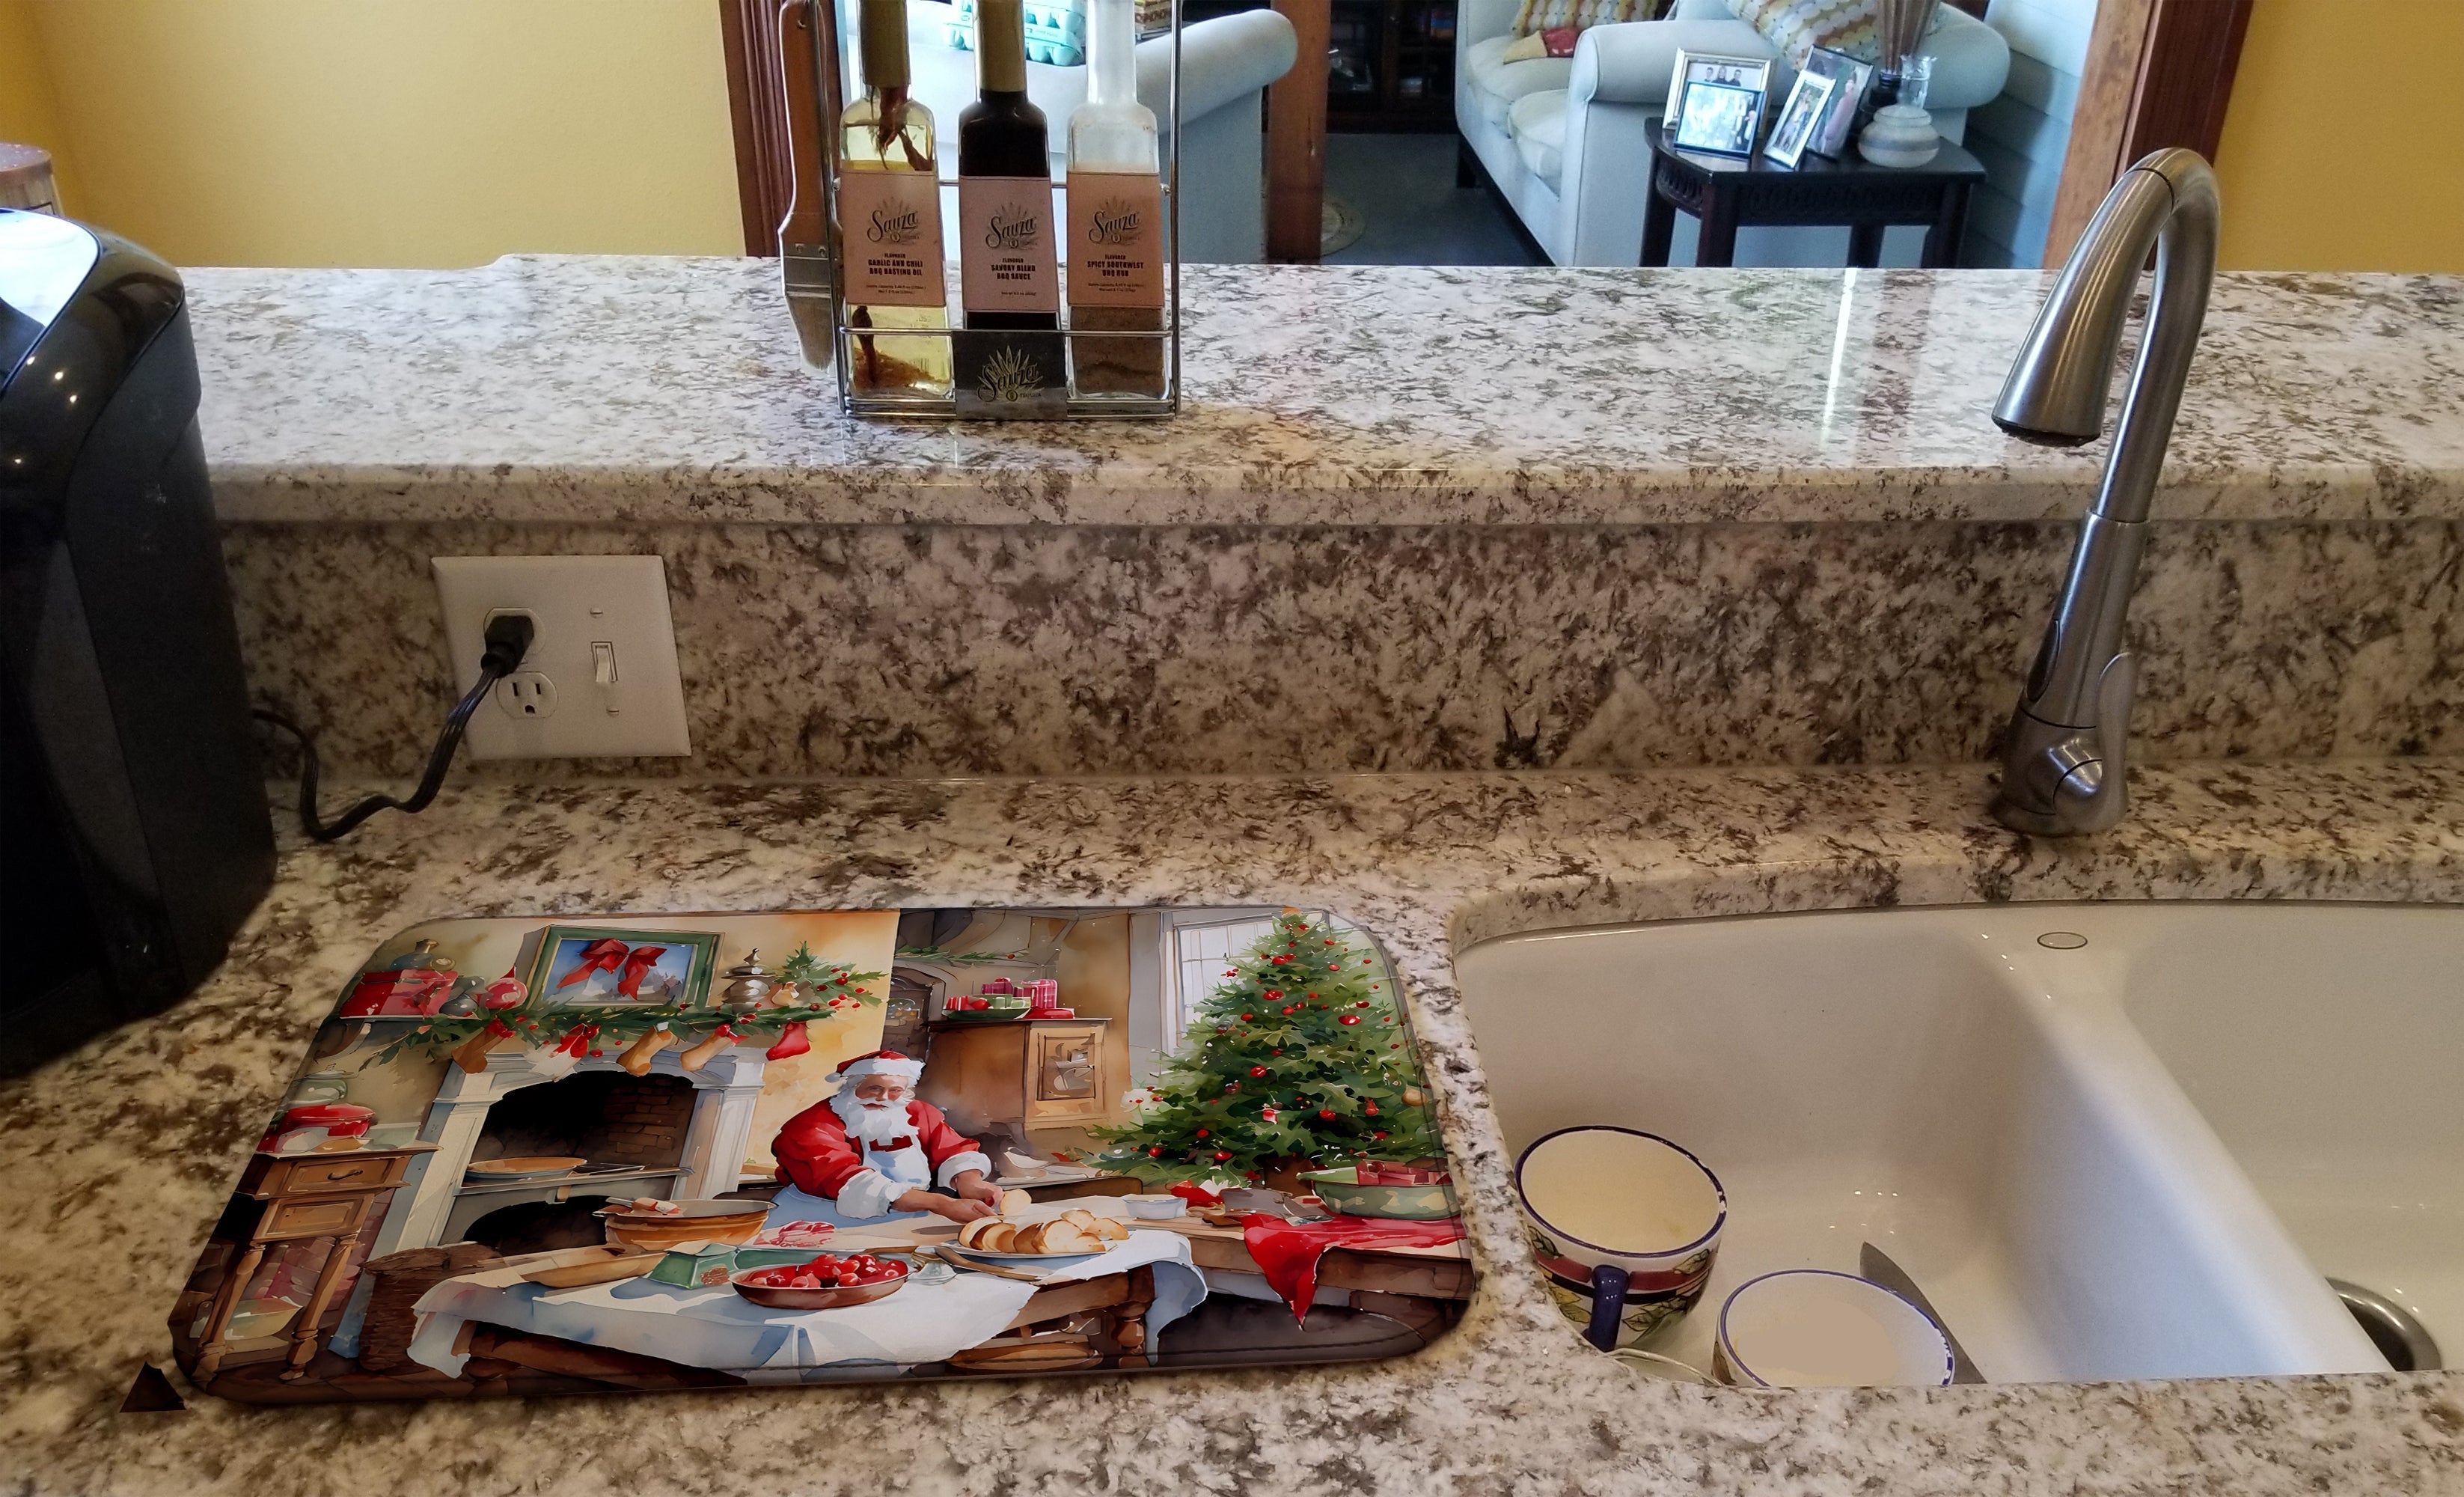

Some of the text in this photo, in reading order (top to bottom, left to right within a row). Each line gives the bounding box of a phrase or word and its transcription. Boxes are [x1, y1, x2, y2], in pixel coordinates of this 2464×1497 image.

[867, 210, 917, 243] Sauza
[985, 216, 1036, 249] Sauza
[1089, 211, 1138, 244] Sauza
[977, 365, 1042, 403] Sauza
